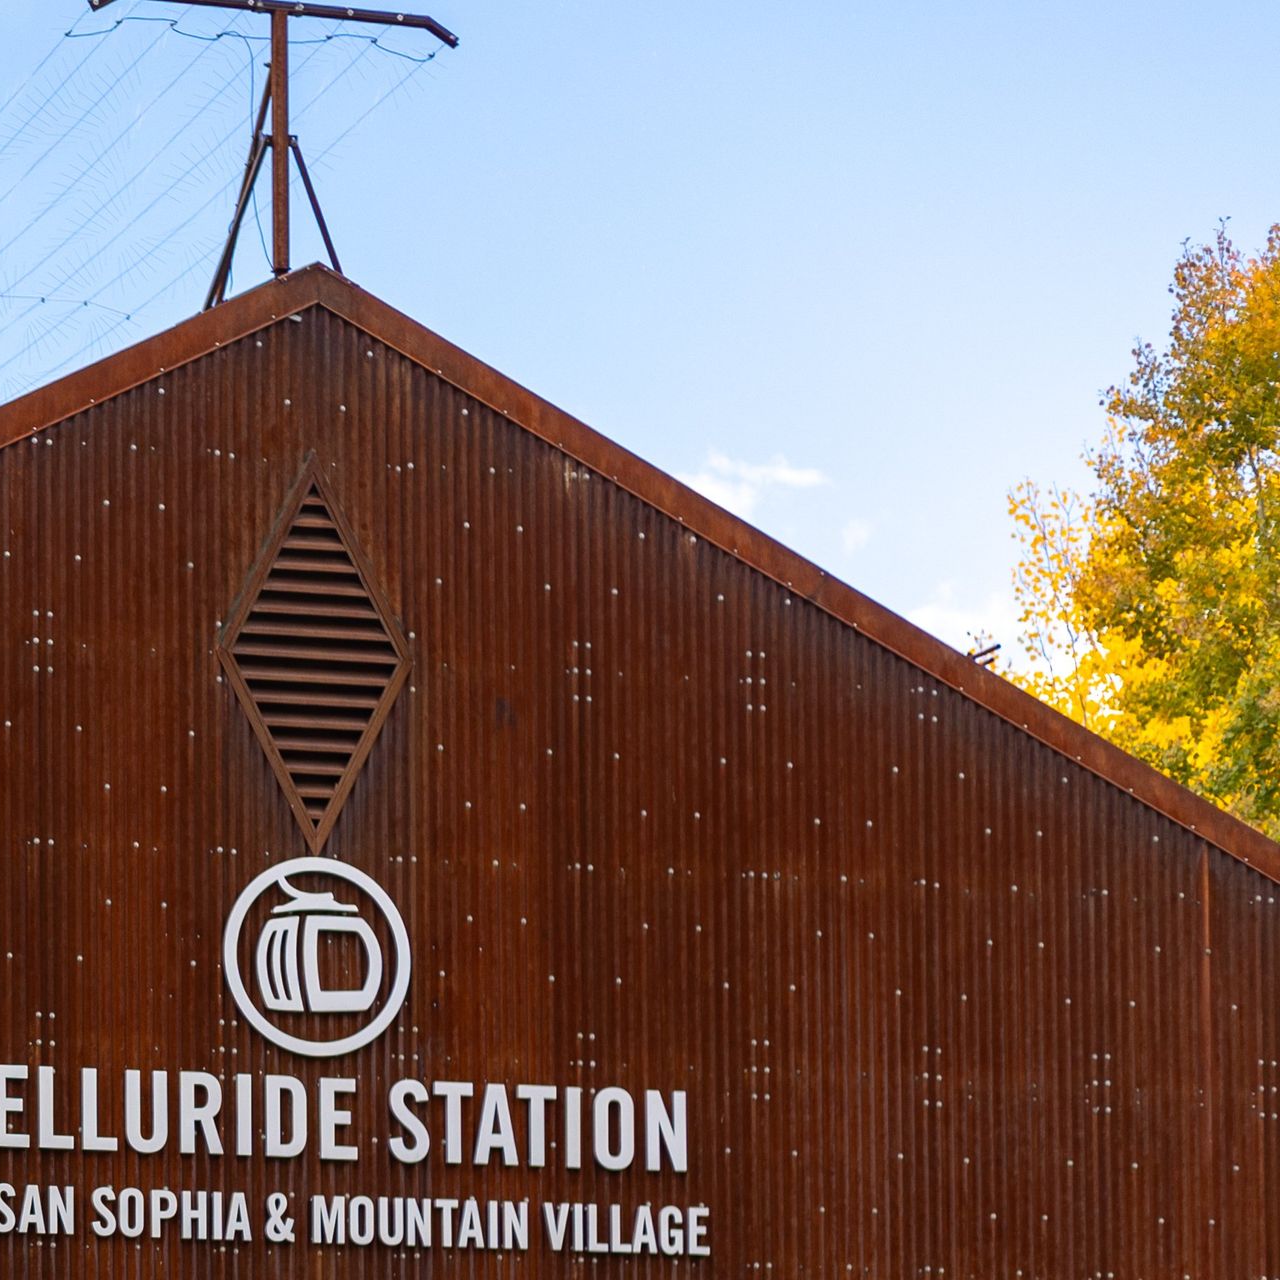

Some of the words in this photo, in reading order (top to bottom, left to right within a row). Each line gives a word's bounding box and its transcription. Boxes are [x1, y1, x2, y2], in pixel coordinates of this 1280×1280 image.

[387, 1078, 690, 1174] STATION
[91, 1185, 253, 1243] SOPHIA
[265, 1191, 296, 1244] &
[311, 1194, 531, 1252] MOUNTAIN
[543, 1200, 713, 1258] VILLAGE
